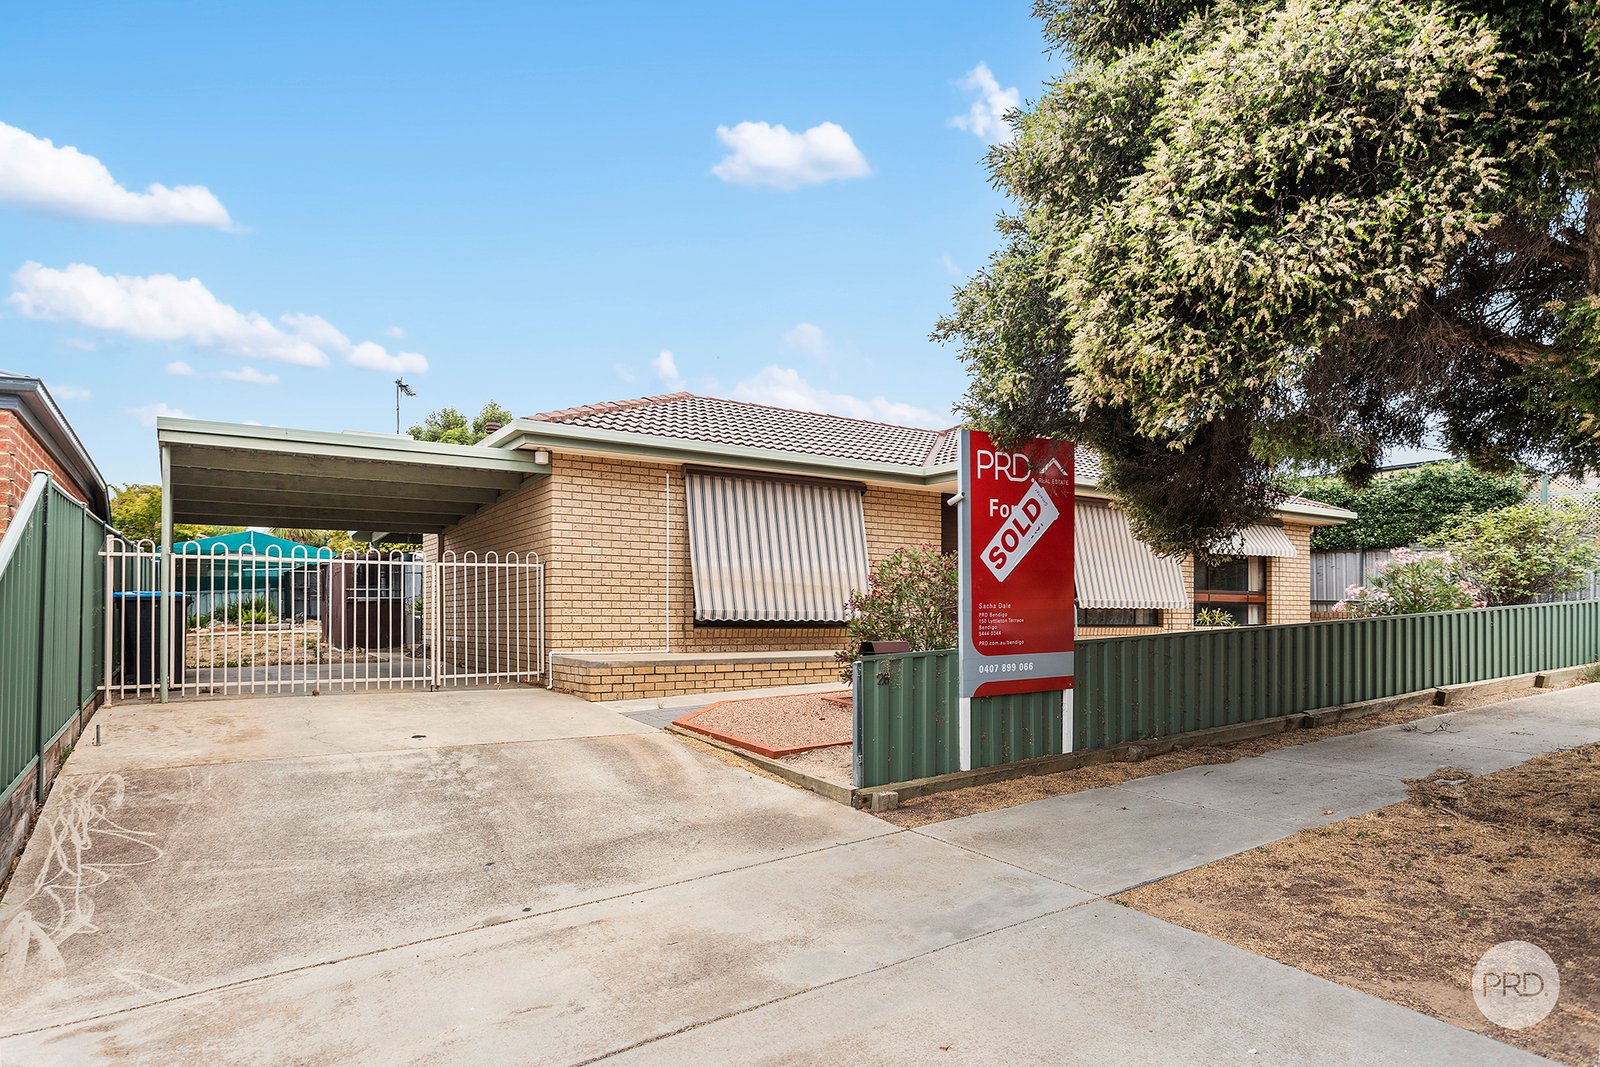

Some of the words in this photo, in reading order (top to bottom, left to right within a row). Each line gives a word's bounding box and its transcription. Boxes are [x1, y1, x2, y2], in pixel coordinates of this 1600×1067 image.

[988, 498, 1042, 570] SOLD
[978, 602, 997, 610] Sacha
[978, 664, 999, 674] 0407
[1001, 663, 1017, 672] 899
[1018, 662, 1034, 671] 066
